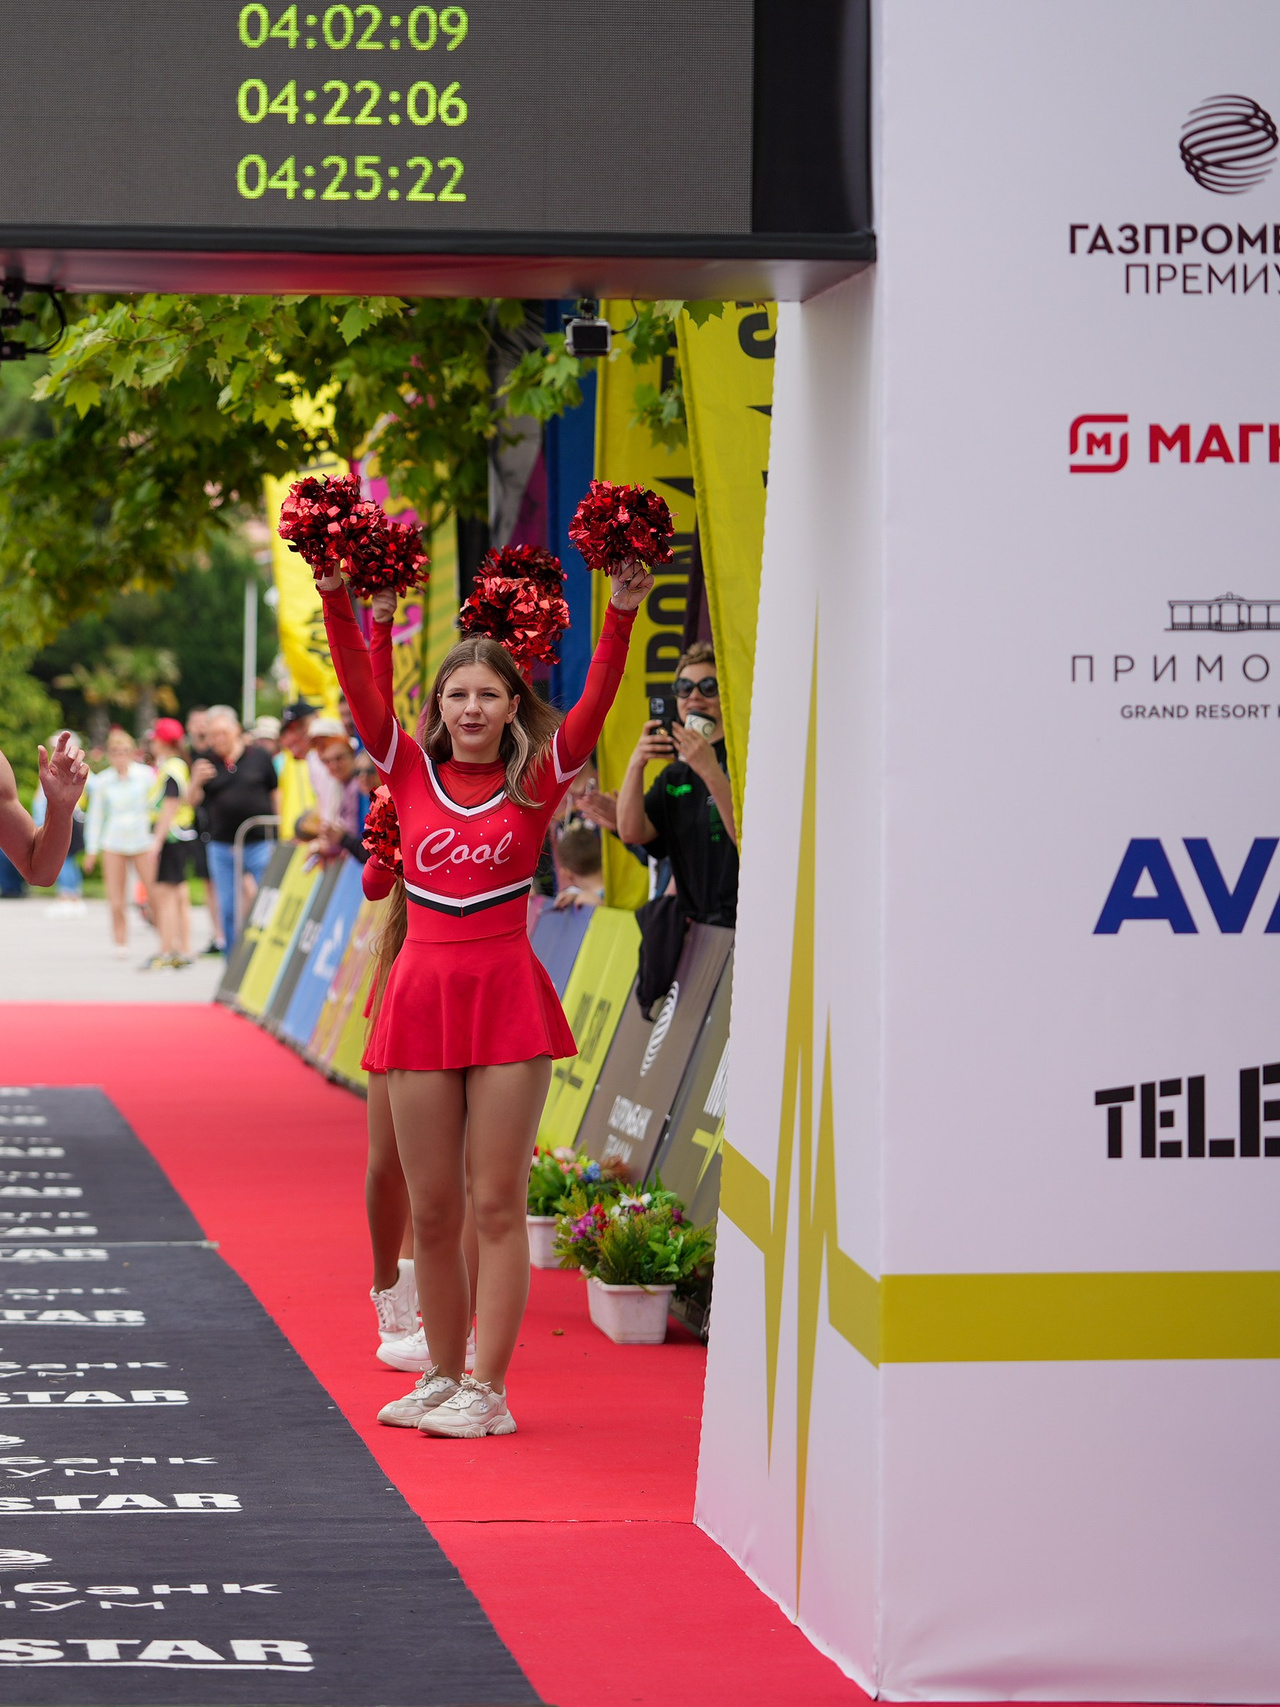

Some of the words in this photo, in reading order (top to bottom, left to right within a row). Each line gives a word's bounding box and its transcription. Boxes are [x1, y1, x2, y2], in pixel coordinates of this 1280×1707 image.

[237, 3, 469, 51] 04:02:09
[236, 78, 468, 126] 04:22:06
[236, 154, 467, 202] 04:25:22
[1069, 223, 1280, 255] ГАЗПРОМ
[1125, 262, 1280, 294] ПРЕМИ
[1071, 654, 1270, 683] ПРИМО
[1121, 704, 1190, 719] GRAND
[1195, 704, 1271, 719] RESORT
[415, 827, 514, 873] Cool
[1092, 837, 1280, 934] AV
